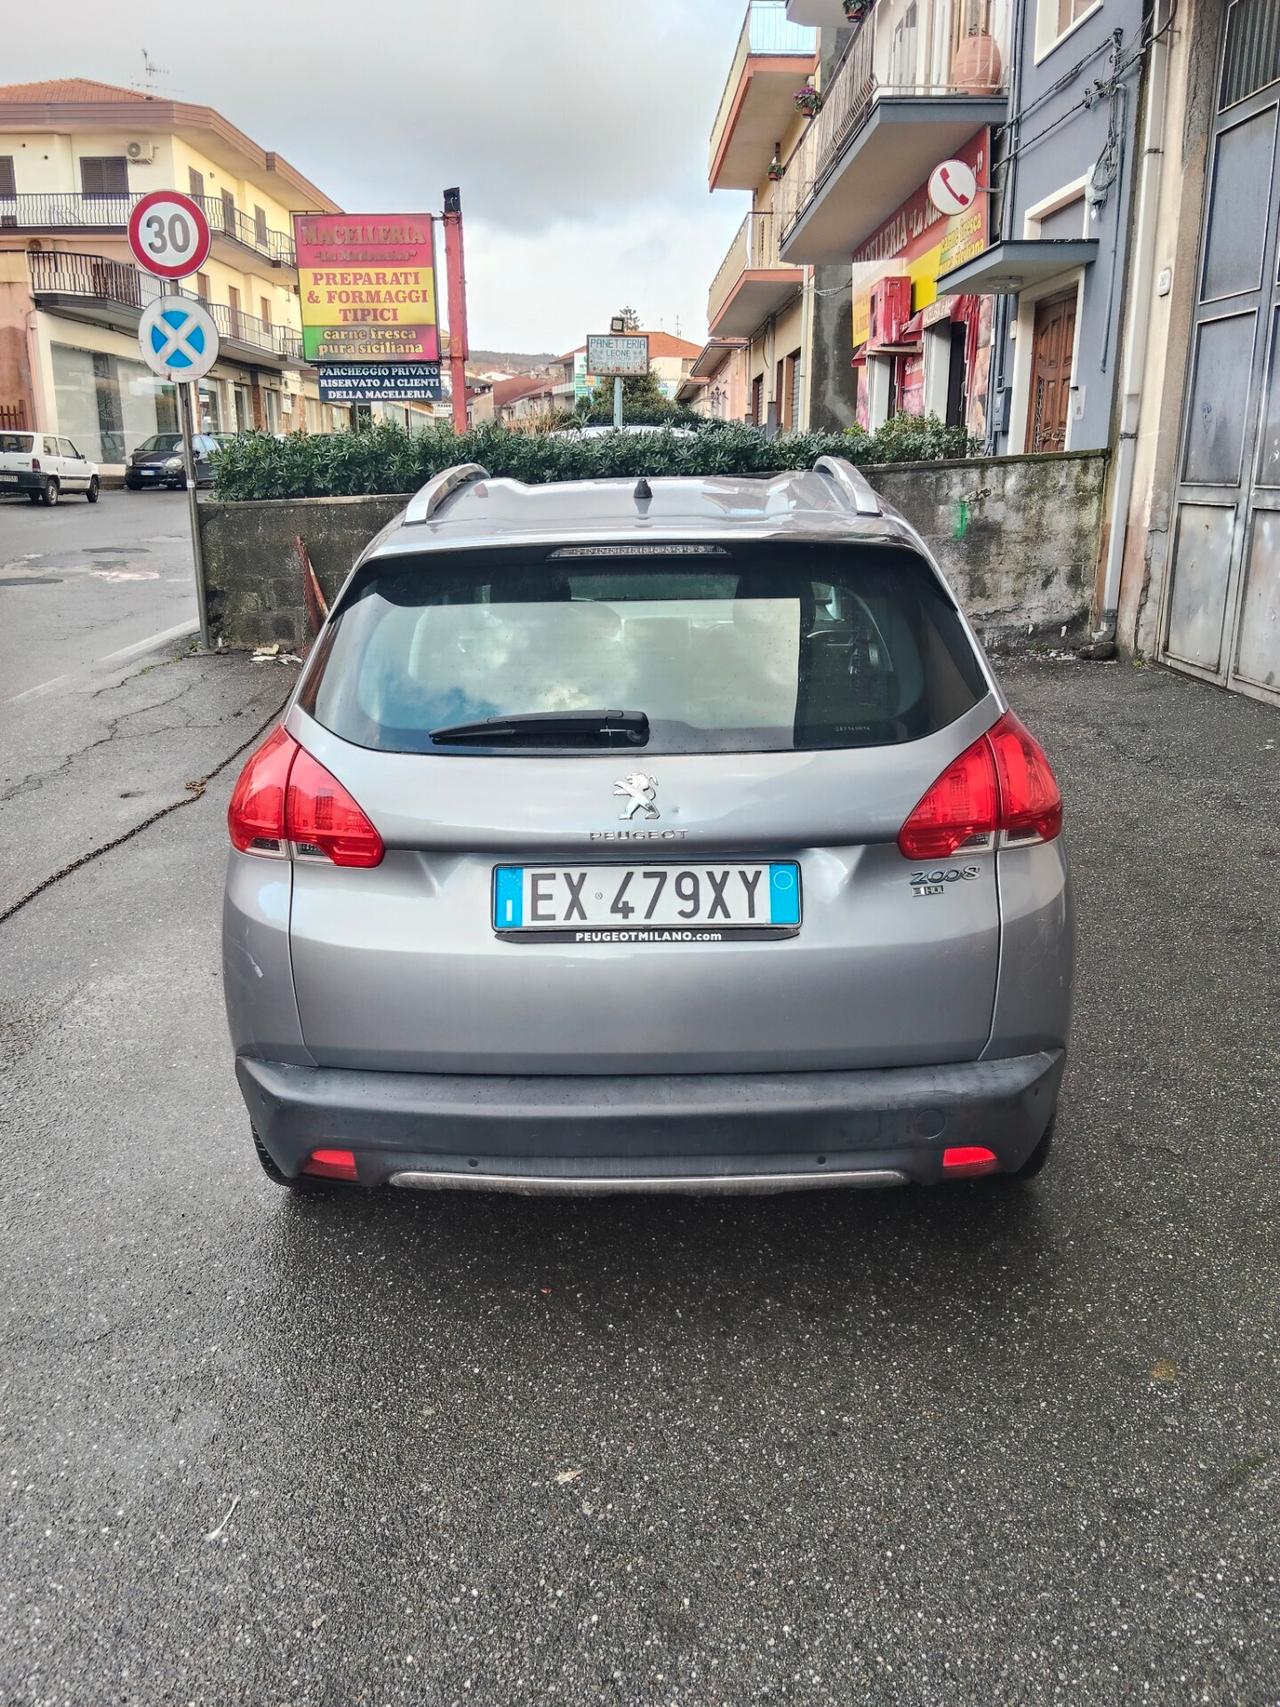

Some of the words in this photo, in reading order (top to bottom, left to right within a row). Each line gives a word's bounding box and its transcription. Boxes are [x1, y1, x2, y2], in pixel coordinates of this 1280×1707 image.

[146, 213, 191, 255] 30
[852, 210, 908, 263] ELLERIA
[312, 271, 420, 286] PREPARATI
[307, 290, 321, 304] &
[326, 289, 428, 304] FORMAGGI
[339, 307, 399, 322] TIPICI
[323, 328, 371, 341] carne
[370, 326, 417, 340] fresca
[318, 344, 359, 357] pura
[359, 341, 424, 355] siciliana
[590, 338, 646, 349] PANETTERIA
[319, 366, 389, 377] PARCHEGGIO
[391, 366, 438, 376] PRIVATO
[320, 378, 381, 388] RISERVATO
[396, 378, 440, 388] CLIENTI
[328, 390, 366, 400] DELLA
[365, 389, 434, 399] MACELLERIA
[589, 829, 688, 841] PEUGEOT
[909, 865, 981, 886] 2008
[530, 872, 588, 922] EX
[610, 869, 762, 920] 479XY
[575, 931, 722, 942] PEUGEOTMILANO.com
